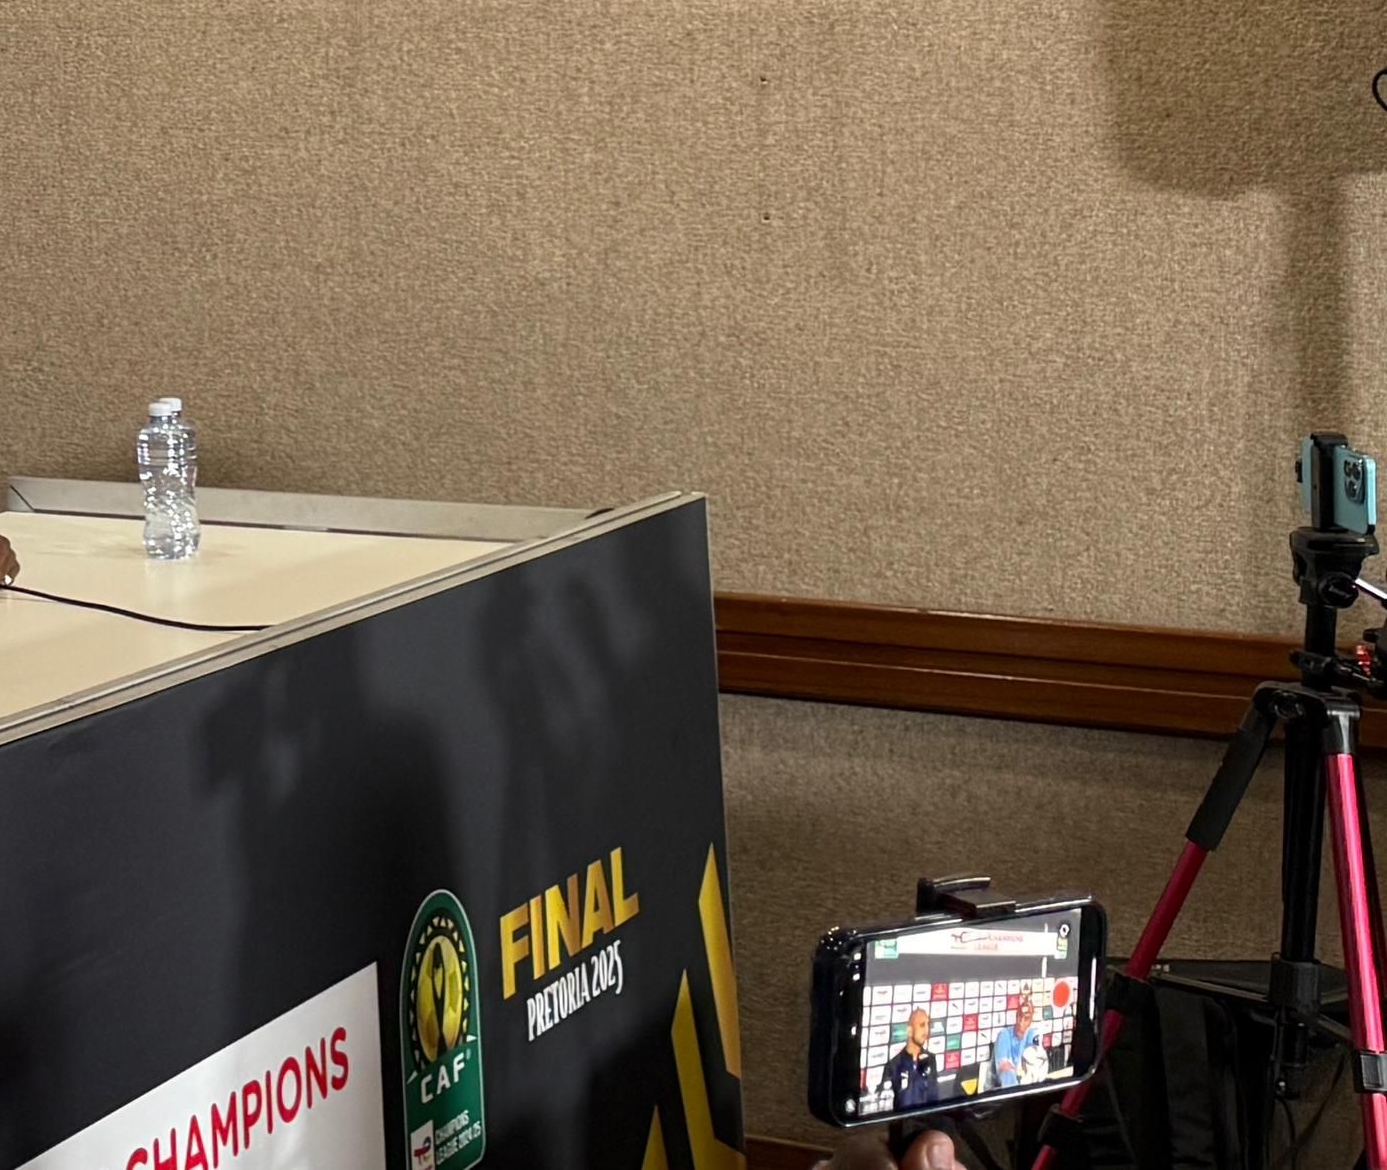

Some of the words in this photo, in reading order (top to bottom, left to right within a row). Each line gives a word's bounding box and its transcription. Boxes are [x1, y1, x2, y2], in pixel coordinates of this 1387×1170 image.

[500, 847, 638, 1001] FINAL
[527, 963, 590, 1041] PRETORIA
[591, 940, 622, 996] 2025
[422, 1052, 465, 1102] CAF
